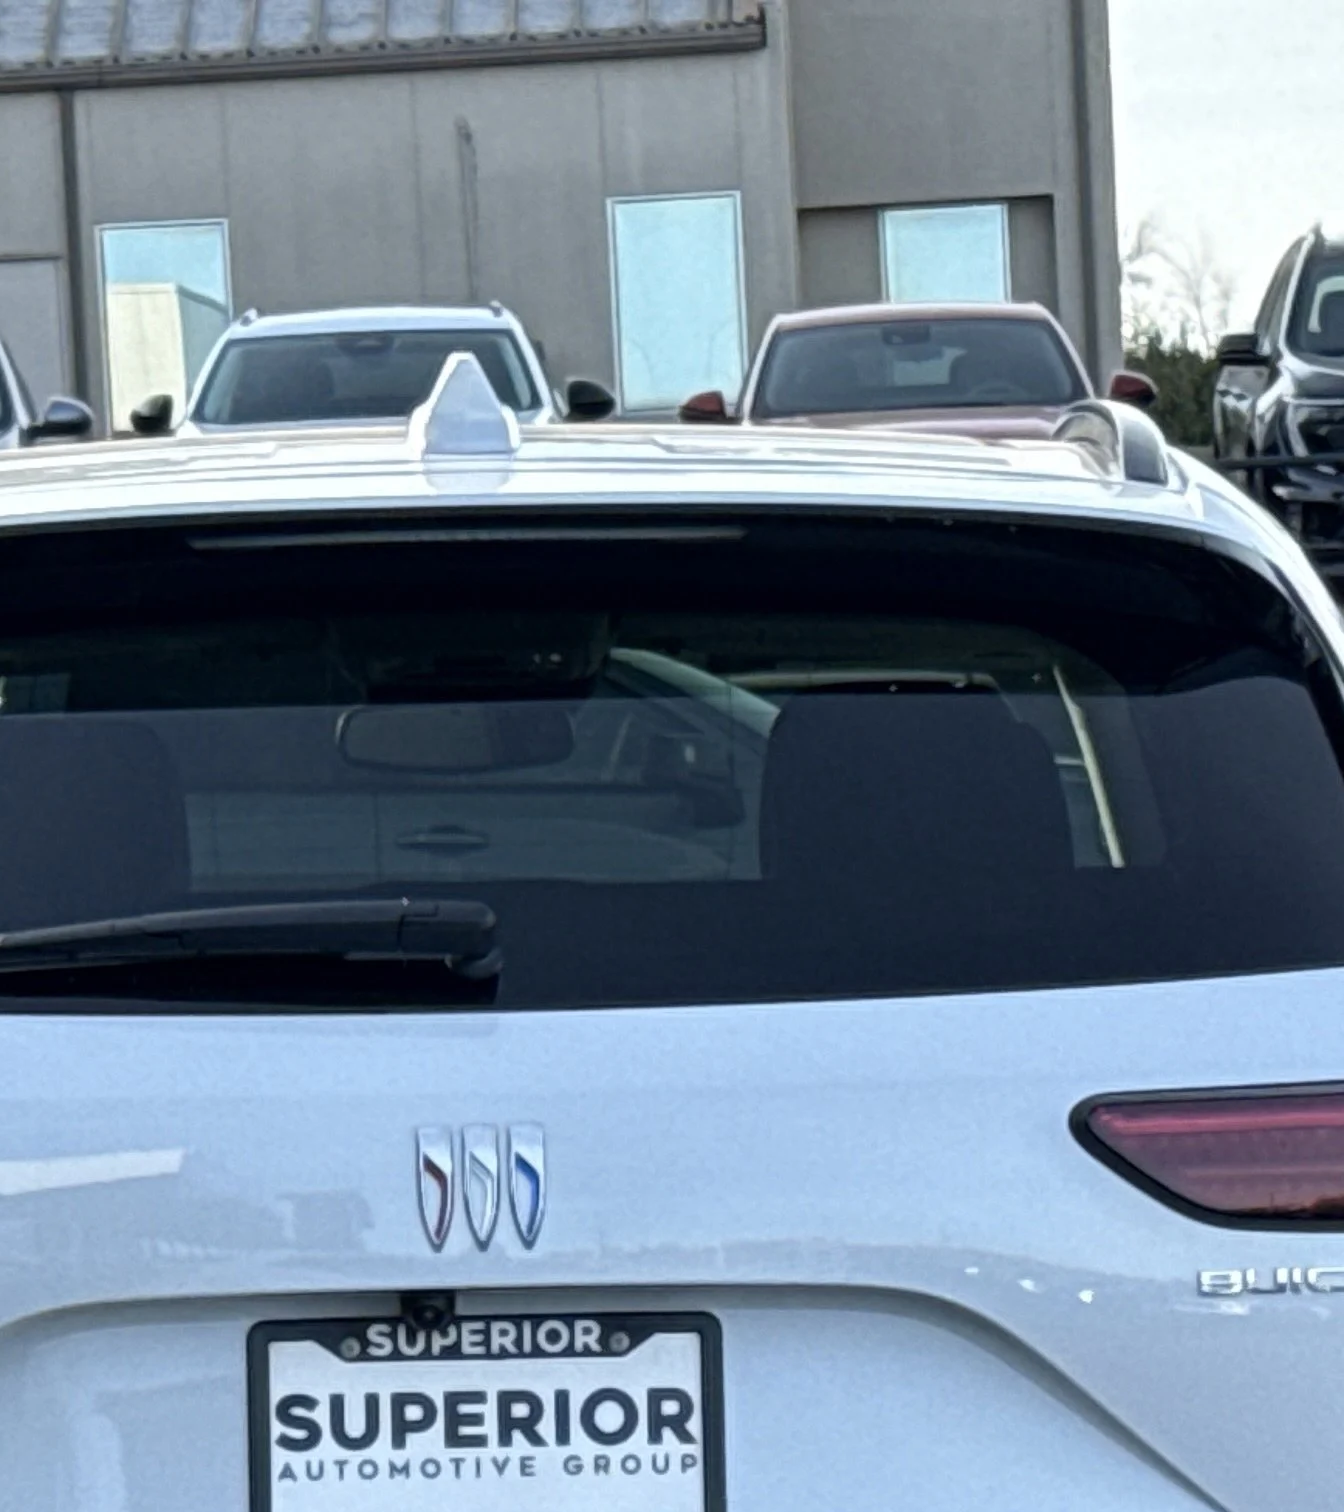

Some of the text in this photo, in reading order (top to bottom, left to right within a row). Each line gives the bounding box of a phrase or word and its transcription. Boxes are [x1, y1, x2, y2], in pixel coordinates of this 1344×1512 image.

[365, 1319, 603, 1357] SUPERIOR
[274, 1387, 698, 1452] SUPERIOR
[277, 1453, 698, 1482] AUTOMOTIVE GROUP
